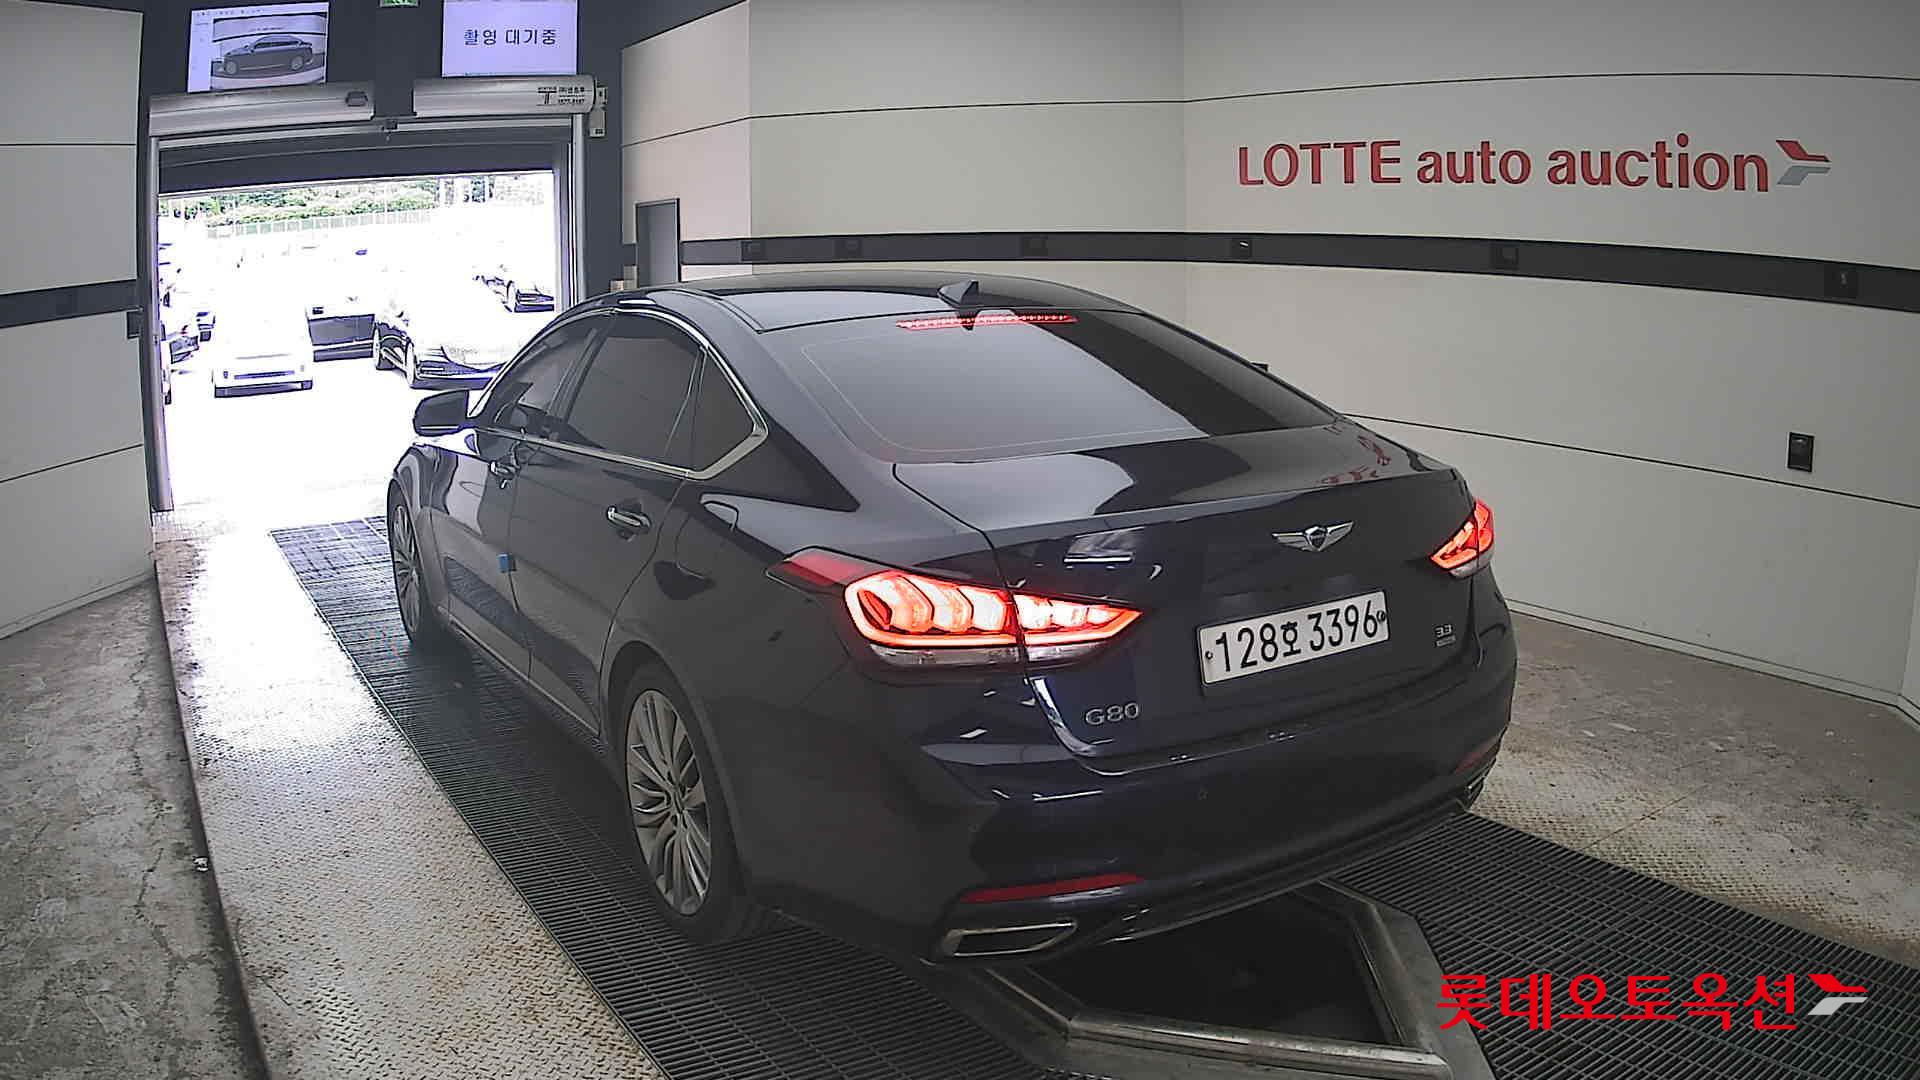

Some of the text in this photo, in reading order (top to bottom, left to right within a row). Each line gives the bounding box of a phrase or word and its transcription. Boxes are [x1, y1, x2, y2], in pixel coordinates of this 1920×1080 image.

[465, 29, 556, 45] 촬영 대기중
[1239, 133, 1769, 192] LOTTE auto auction
[1215, 600, 1377, 673] 128호 3396
[1085, 703, 1140, 726] G80
